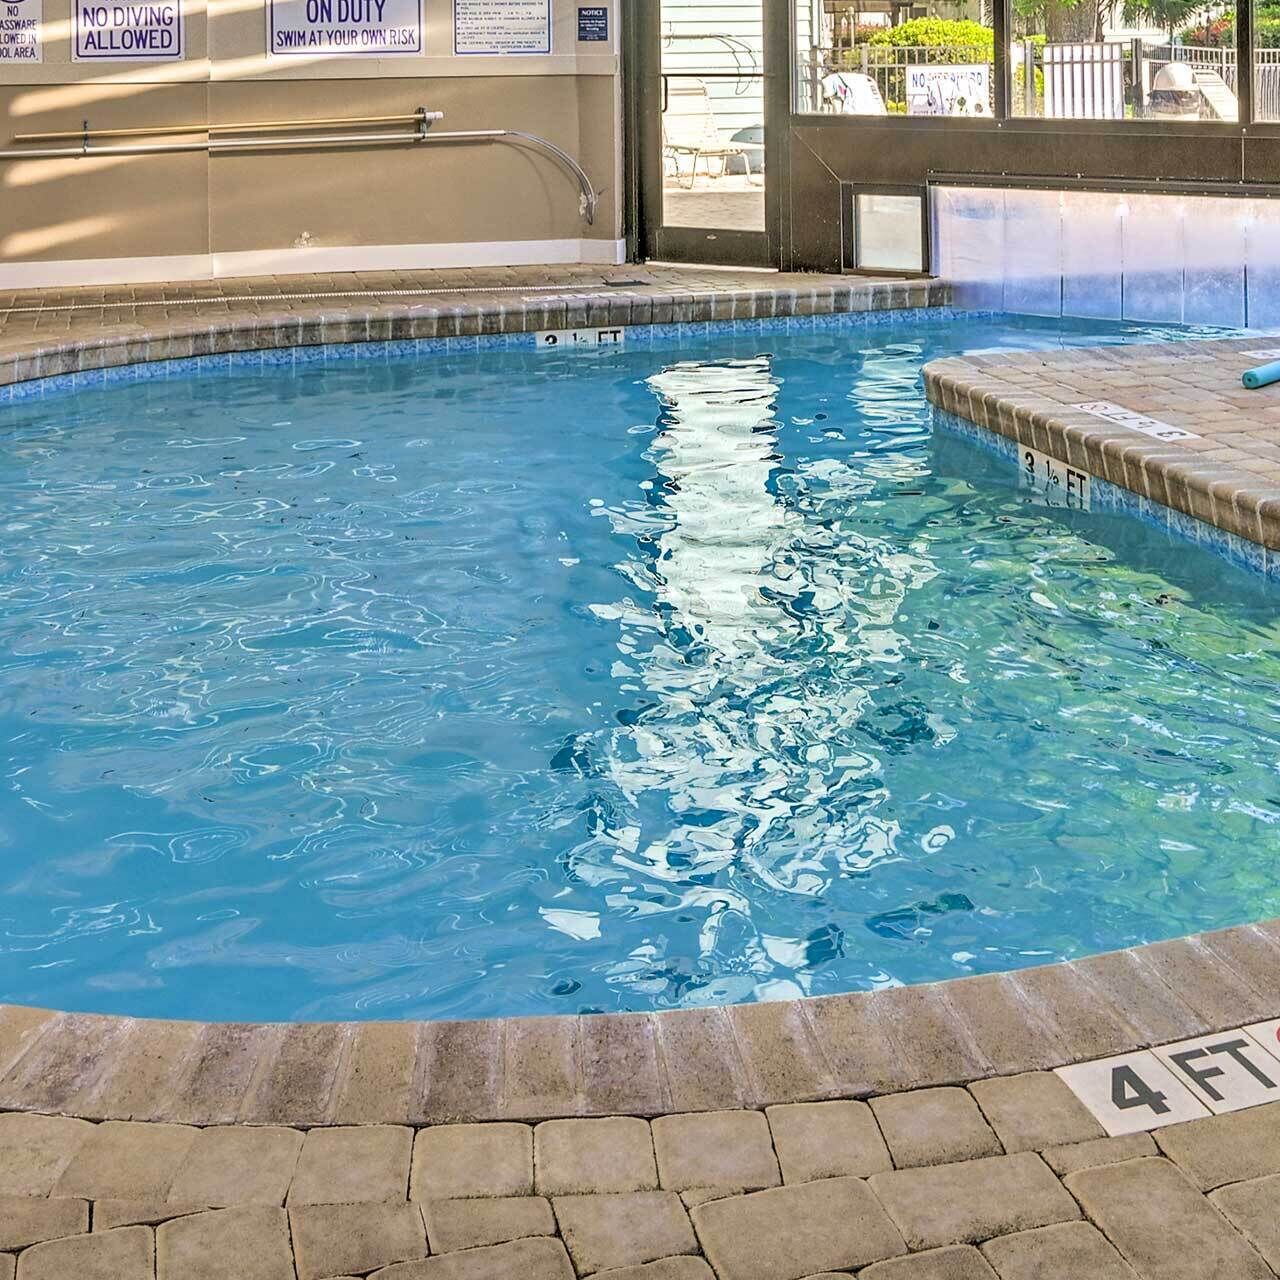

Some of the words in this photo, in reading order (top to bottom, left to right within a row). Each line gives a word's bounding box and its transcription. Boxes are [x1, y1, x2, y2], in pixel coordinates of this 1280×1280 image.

[7, 5, 19, 17] NO
[83, 7, 108, 27] NO
[113, 6, 173, 26] DIVING
[28, 33, 37, 45] IN
[84, 29, 173, 50] ALLOWED
[276, 30, 306, 47] SWIM
[308, 30, 323, 46] AT
[326, 29, 358, 45] YOUR
[361, 29, 387, 45] OWN
[389, 28, 416, 45] RISK
[13, 46, 36, 58] AREA
[912, 72, 926, 88] NO
[1066, 468, 1087, 498] FT
[1111, 1064, 1172, 1115] 4
[1168, 1038, 1278, 1102] FT
